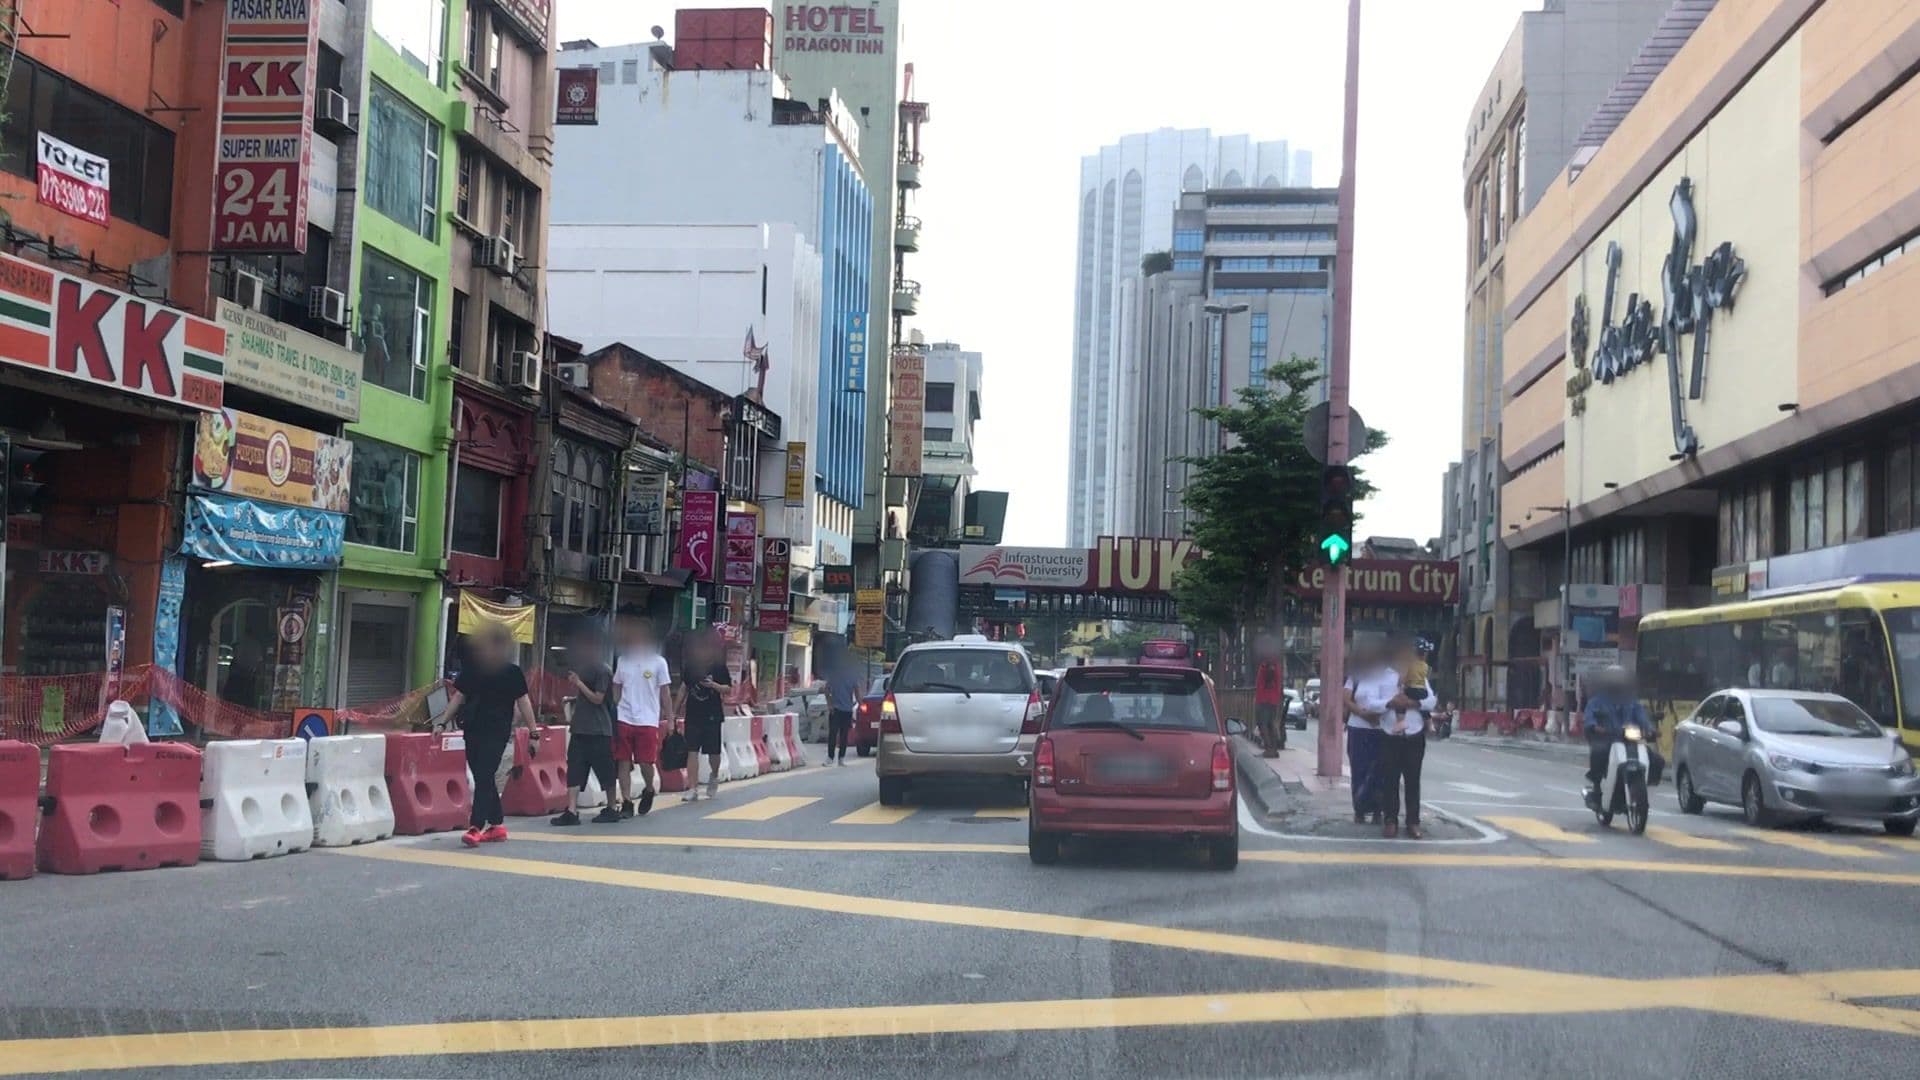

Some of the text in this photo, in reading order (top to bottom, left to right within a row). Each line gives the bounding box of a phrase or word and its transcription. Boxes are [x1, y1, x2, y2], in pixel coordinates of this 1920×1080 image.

[231, 0, 306, 20] PASAR RAYA
[785, 5, 884, 34] HOTEL
[784, 37, 884, 54] DRAGON INN
[226, 61, 302, 97] KK
[222, 137, 297, 158] SUPER MART
[41, 138, 106, 180] TO LET
[222, 168, 291, 217] 24
[220, 221, 289, 243] JAM
[56, 278, 177, 398] KK
[276, 344, 300, 369] TRAVEL
[309, 356, 329, 378] TOURS
[895, 358, 924, 370] HOTEL
[766, 541, 788, 556] 4D
[1005, 551, 1084, 566] Infrastructure
[50, 552, 88, 572] KK
[1025, 564, 1083, 579] University
[1096, 536, 1211, 590] IUK
[1408, 564, 1456, 599] City
